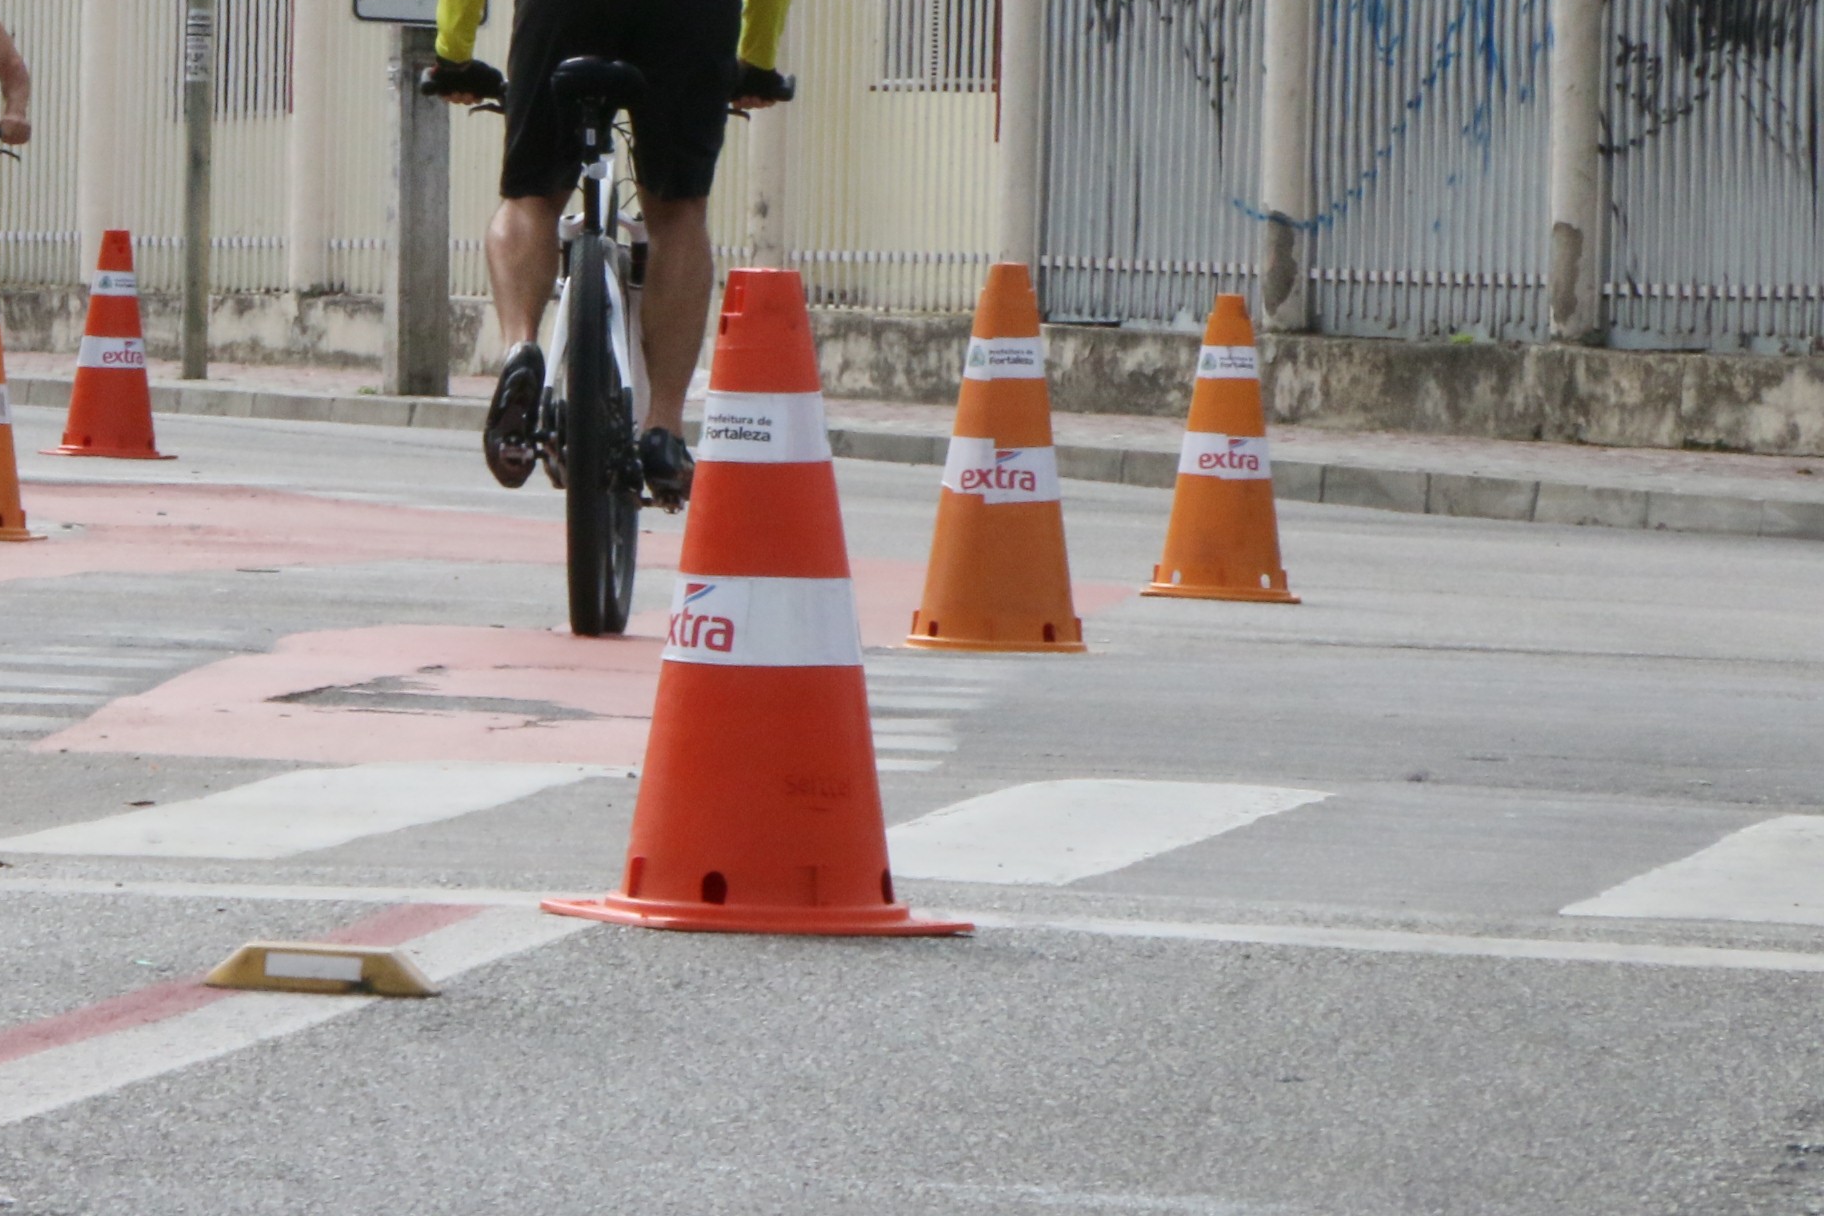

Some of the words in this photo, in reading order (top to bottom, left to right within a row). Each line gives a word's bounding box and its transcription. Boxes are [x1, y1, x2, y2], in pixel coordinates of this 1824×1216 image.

[103, 348, 144, 365] extra
[757, 416, 773, 427] de
[1198, 449, 1260, 471] extra
[960, 464, 1036, 492] extra
